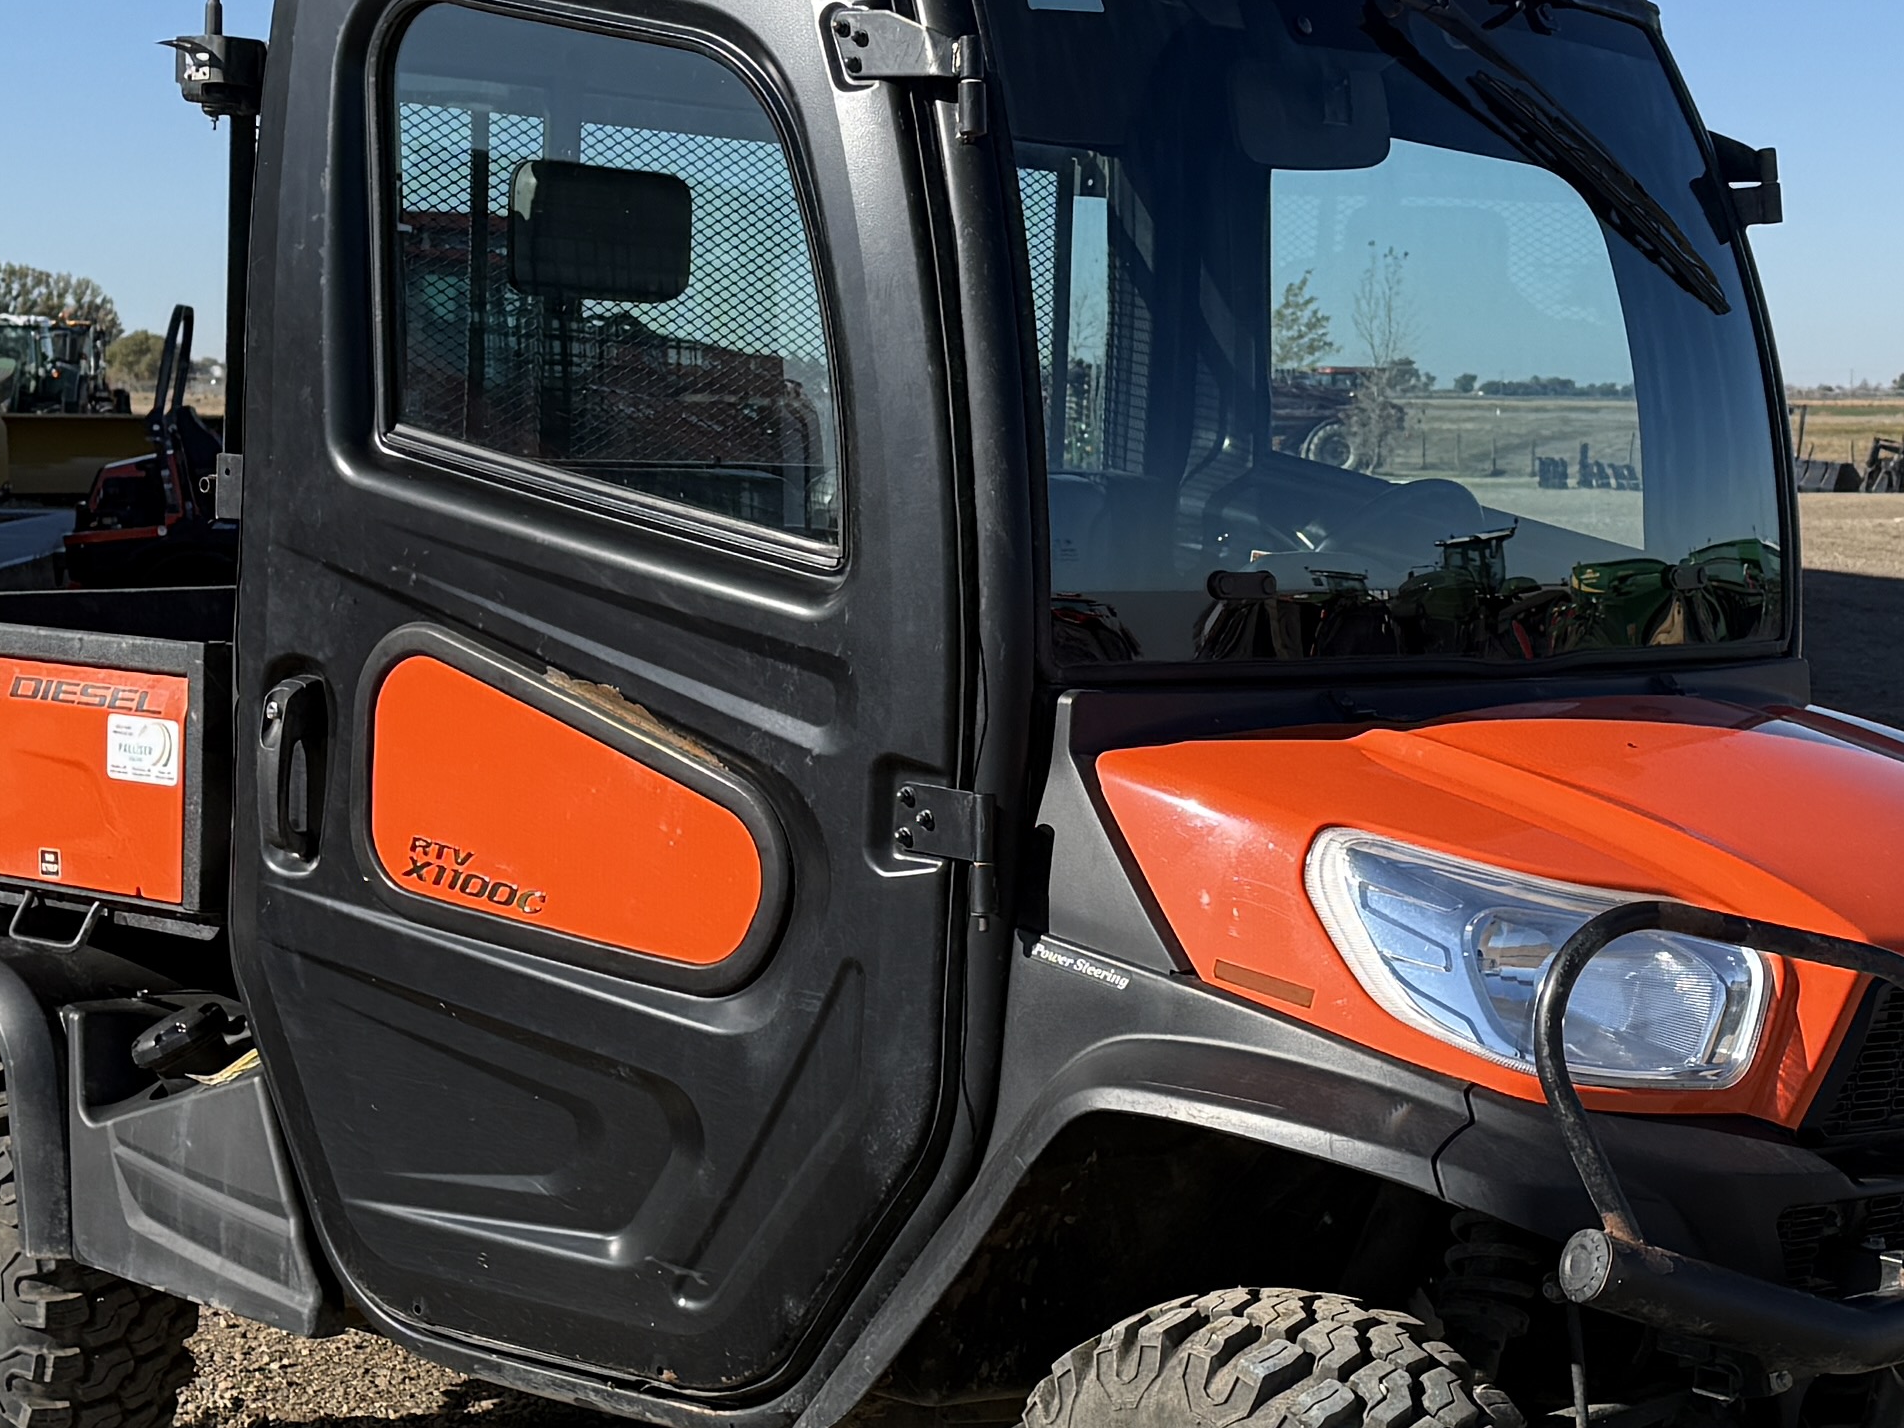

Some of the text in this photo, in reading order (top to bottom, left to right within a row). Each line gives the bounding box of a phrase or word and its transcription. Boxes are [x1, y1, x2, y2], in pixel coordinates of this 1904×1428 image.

[9, 675, 162, 715] DIESEL
[409, 836, 475, 866] RTV
[401, 855, 546, 914] X1100C
[1032, 942, 1130, 990] Power Steering
